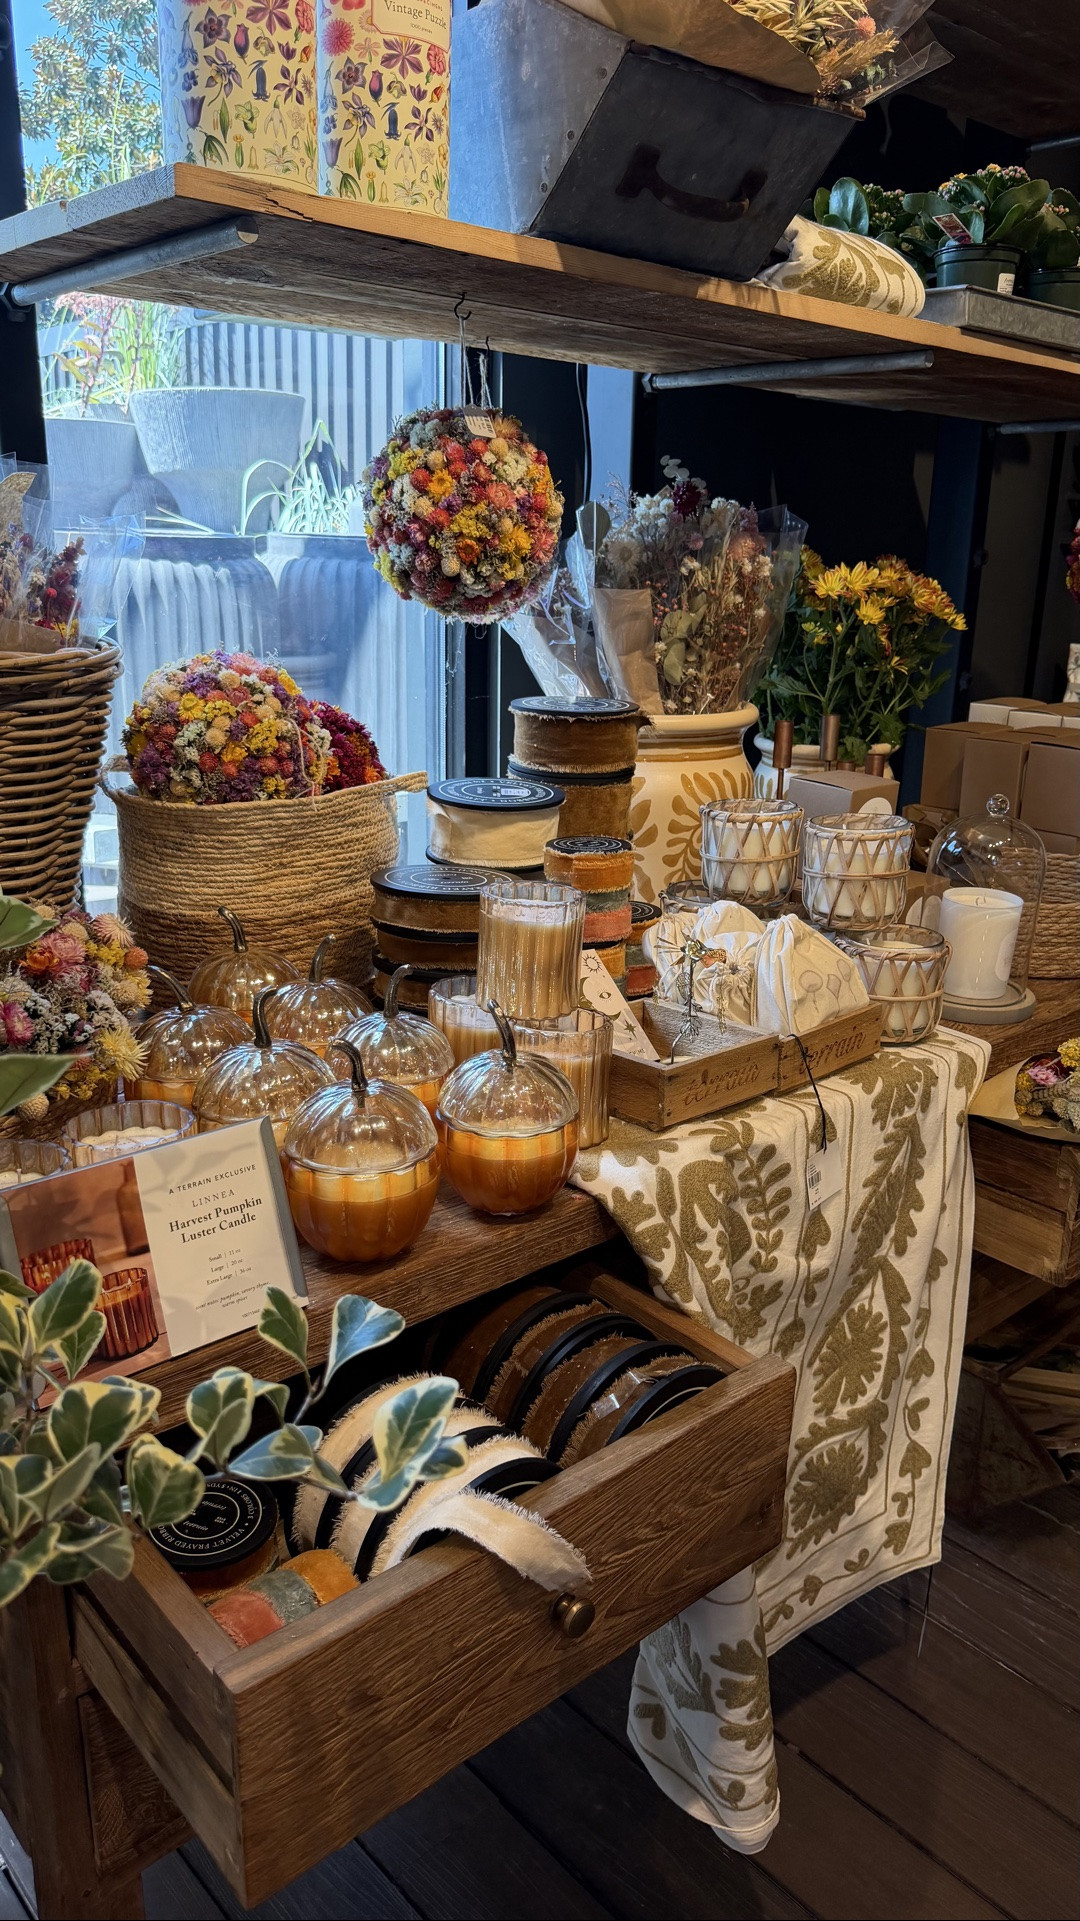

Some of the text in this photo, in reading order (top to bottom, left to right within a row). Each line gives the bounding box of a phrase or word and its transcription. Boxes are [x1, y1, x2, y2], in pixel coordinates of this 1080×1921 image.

[384, 0, 447, 29] Vintage Puzzle
[685, 1056, 761, 1106] terrain
[177, 1177, 212, 1192] TERRAIN
[214, 1164, 256, 1181] EXCLUSIVE
[192, 1189, 235, 1208] LINNEA
[169, 1197, 262, 1232] Harvest Pumpkin
[181, 1212, 257, 1243] Luster Candle
[208, 1253, 222, 1262] Small
[210, 1265, 224, 1273] Large
[206, 1278, 220, 1286] Extra
[220, 1273, 233, 1281] Large
[158, 1525, 245, 1550] VELVET FRAYED RIBBO
